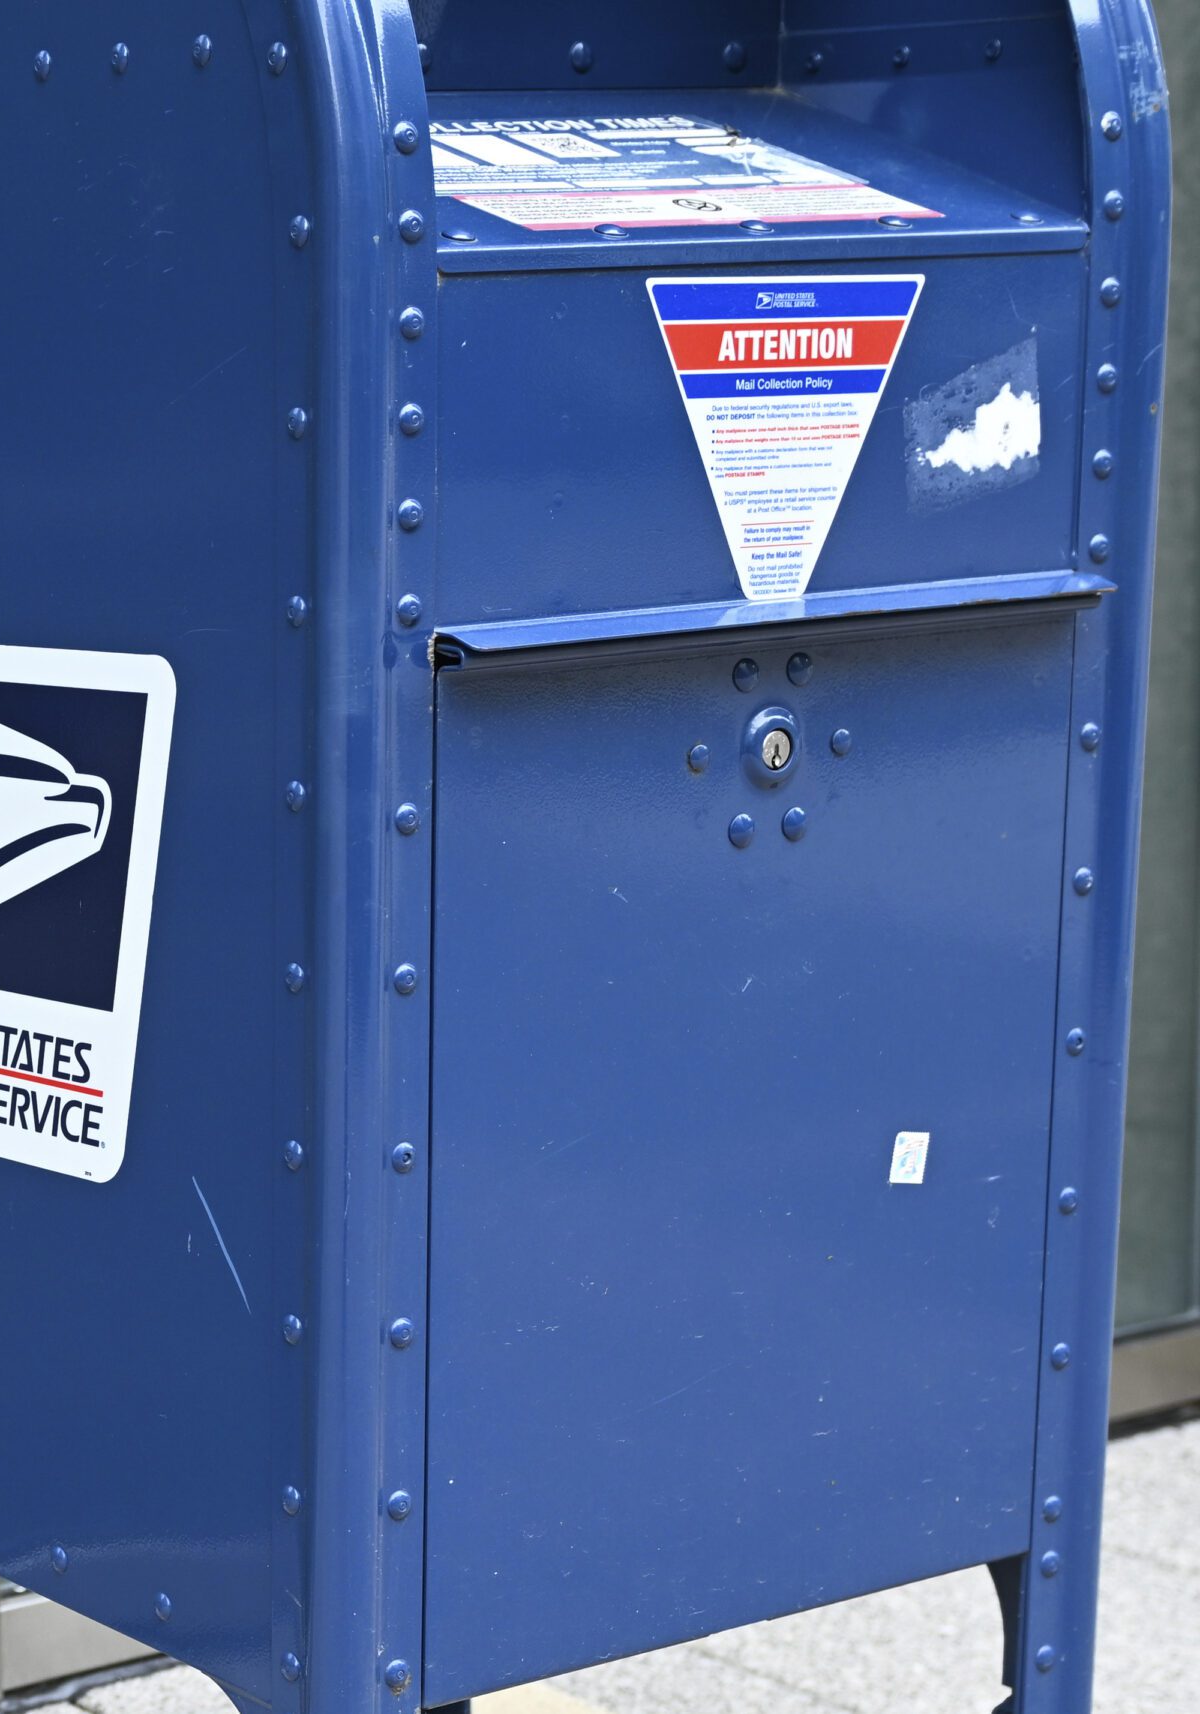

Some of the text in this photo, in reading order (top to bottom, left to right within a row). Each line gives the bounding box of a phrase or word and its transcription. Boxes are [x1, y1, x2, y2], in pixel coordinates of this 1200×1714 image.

[594, 115, 695, 130] TIMES
[718, 328, 853, 362] ATTENTION
[736, 377, 833, 390] Mail Collection Policy
[771, 403, 799, 411] regulations
[778, 563, 803, 571] prohibited
[750, 572, 777, 580] dangerous
[778, 571, 793, 579] goods
